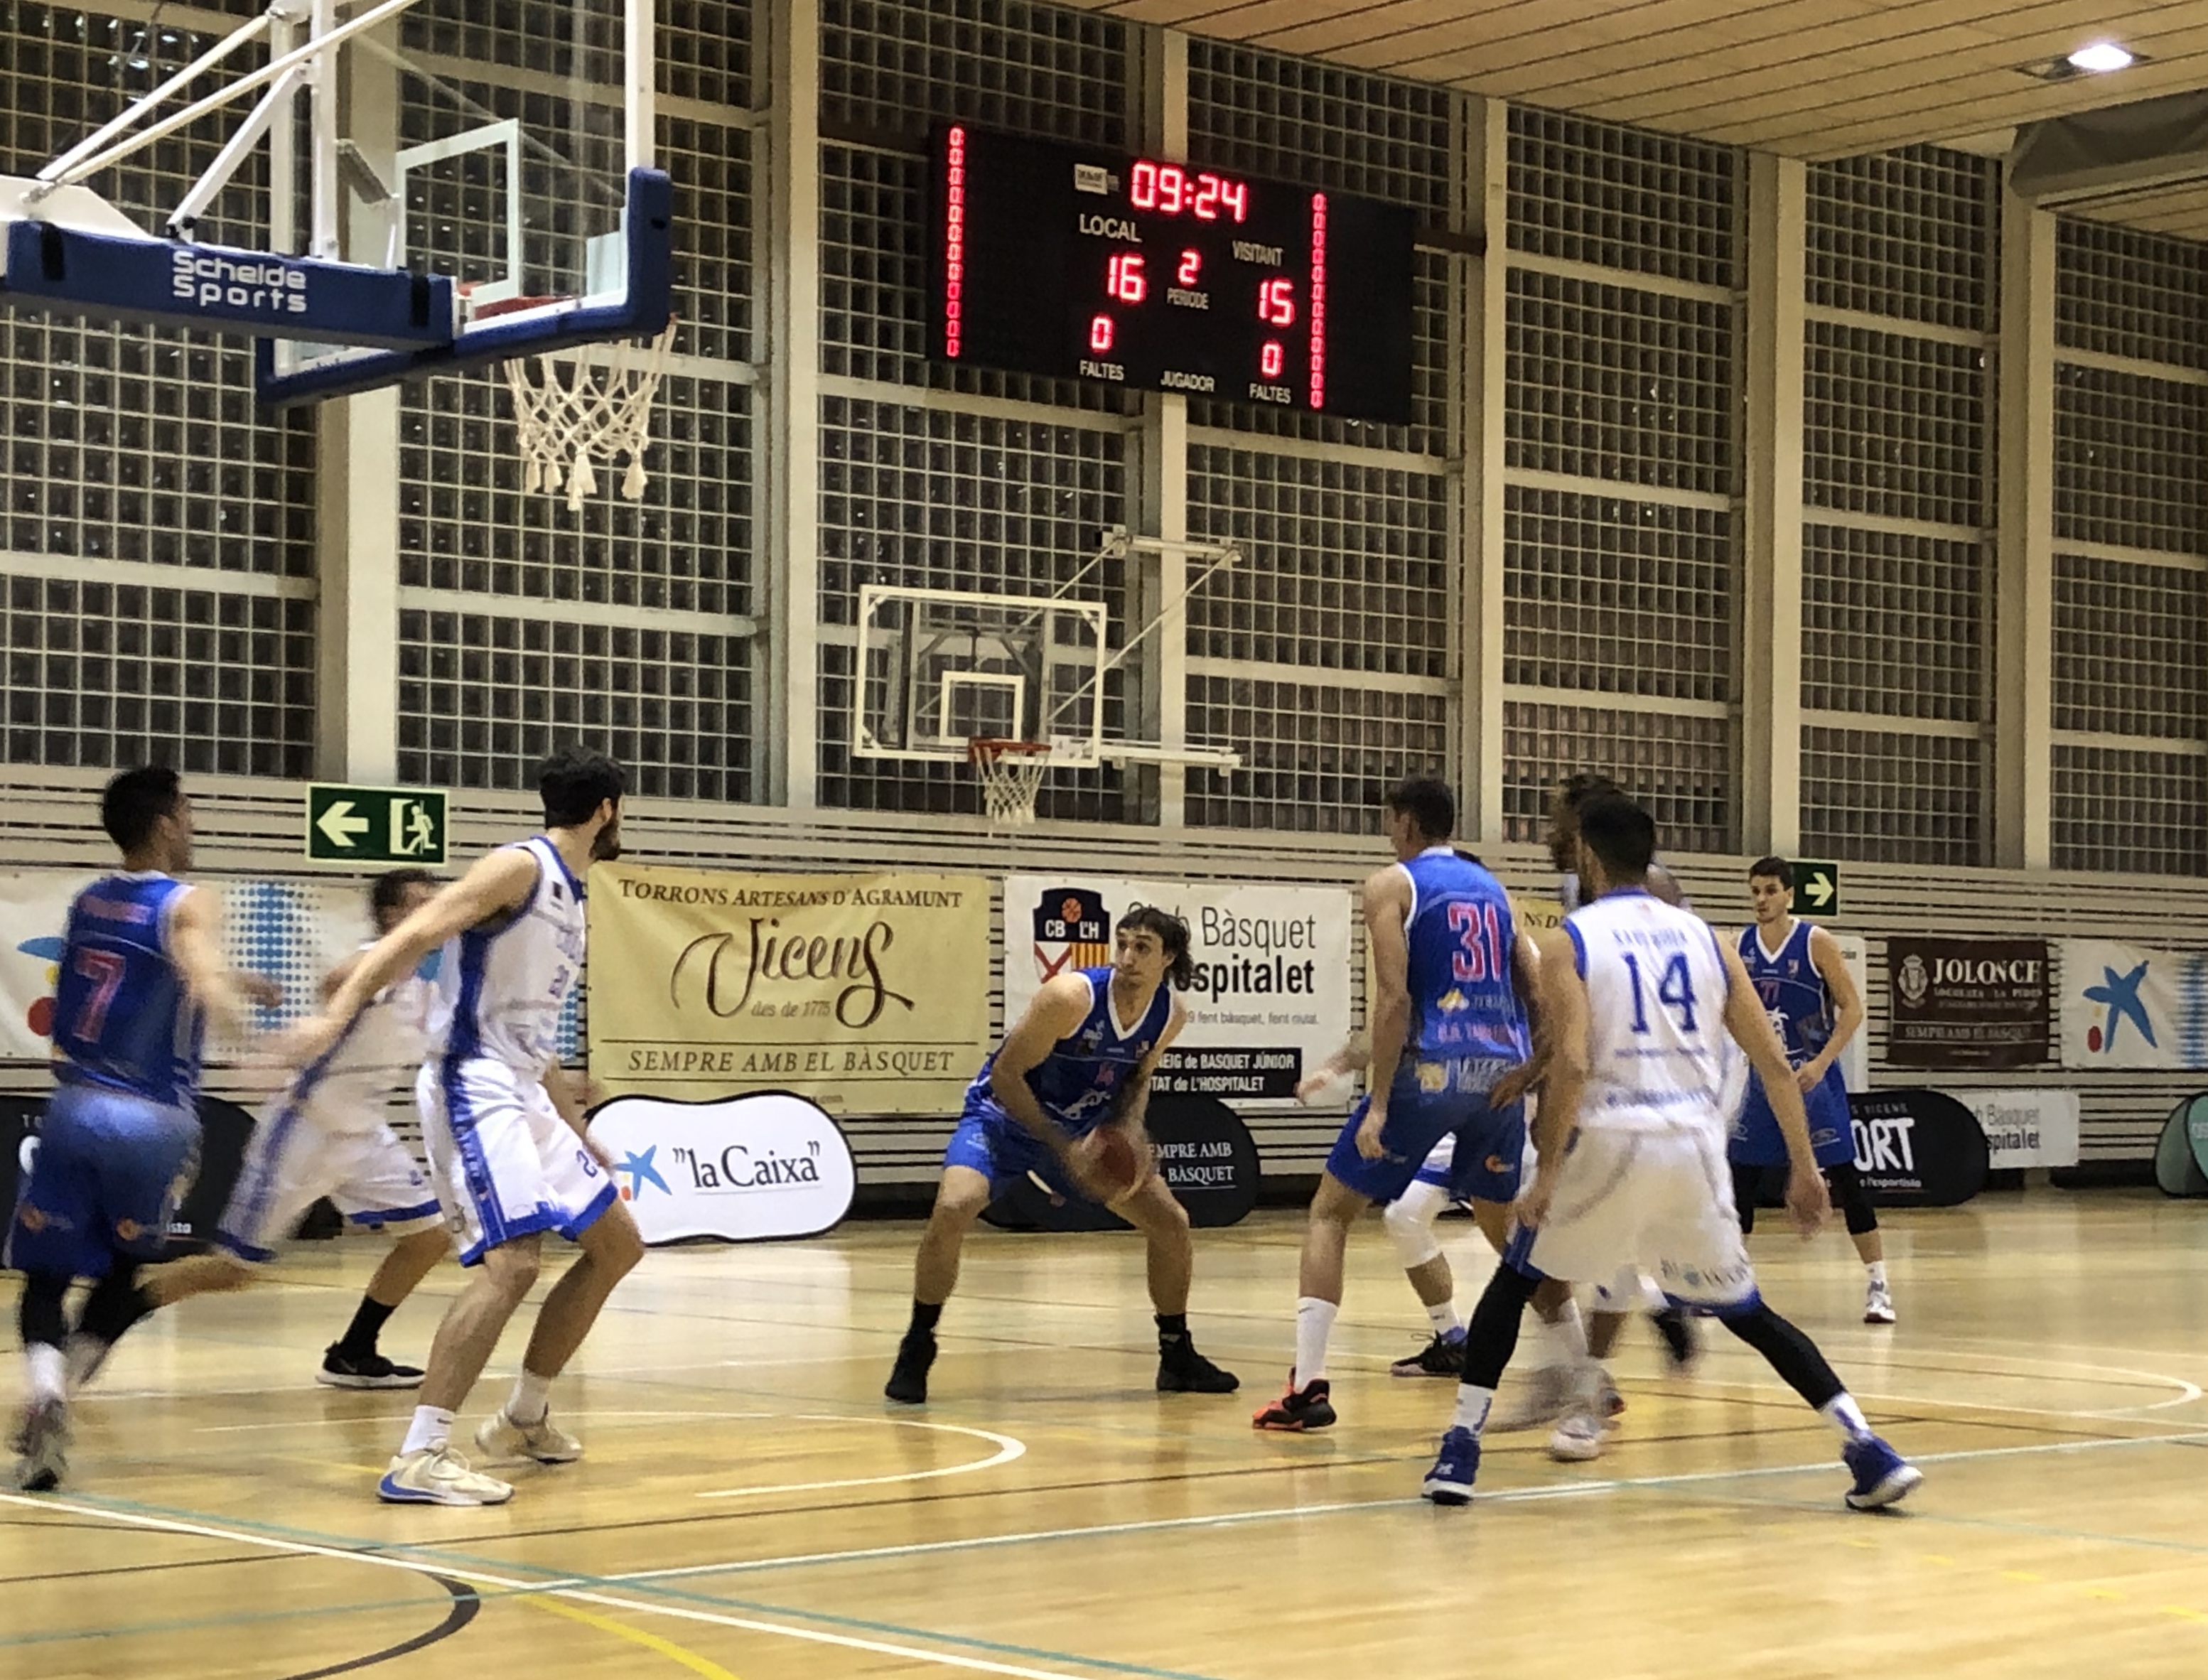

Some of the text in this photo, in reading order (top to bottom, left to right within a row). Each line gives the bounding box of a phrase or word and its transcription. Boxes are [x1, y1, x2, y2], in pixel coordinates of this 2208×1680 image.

[1131, 163, 1248, 222] 09:24
[1079, 213, 1143, 243] LOCAL
[1178, 252, 1202, 284] 2
[1232, 240, 1283, 267] VISITANT
[173, 274, 307, 313] Sports
[1107, 255, 1147, 302] 16
[1258, 281, 1295, 325] 15
[1091, 316, 1113, 350] 0
[1079, 360, 1124, 381] FALTES
[1261, 343, 1283, 376] 0
[1160, 370, 1215, 392] JUGADOR
[1249, 383, 1292, 404] FALTES
[618, 878, 728, 905] TORRONS
[731, 888, 828, 908] ARTESANS
[1045, 919, 1066, 938] CB
[1202, 905, 1317, 957] Bàsquet
[1447, 901, 1502, 982] 31
[670, 917, 915, 1030] Vicens
[1175, 953, 1315, 1003] ospitalet
[74, 946, 127, 1044] 7
[1620, 951, 1699, 1035] 14
[780, 1000, 798, 1018] de
[628, 1046, 955, 1076] SEMPRE AMB EL BÀSQUET
[1185, 1053, 1199, 1070] de
[1200, 1053, 1250, 1070] BASQUET
[1151, 1075, 1266, 1092] TAT de L'HOSPITALET
[1148, 1141, 1233, 1159] EMPRE AMB
[1849, 1116, 1915, 1172] ORT
[1986, 1128, 2041, 1156] spitalet
[1167, 1164, 1235, 1185] BÀSQUET
